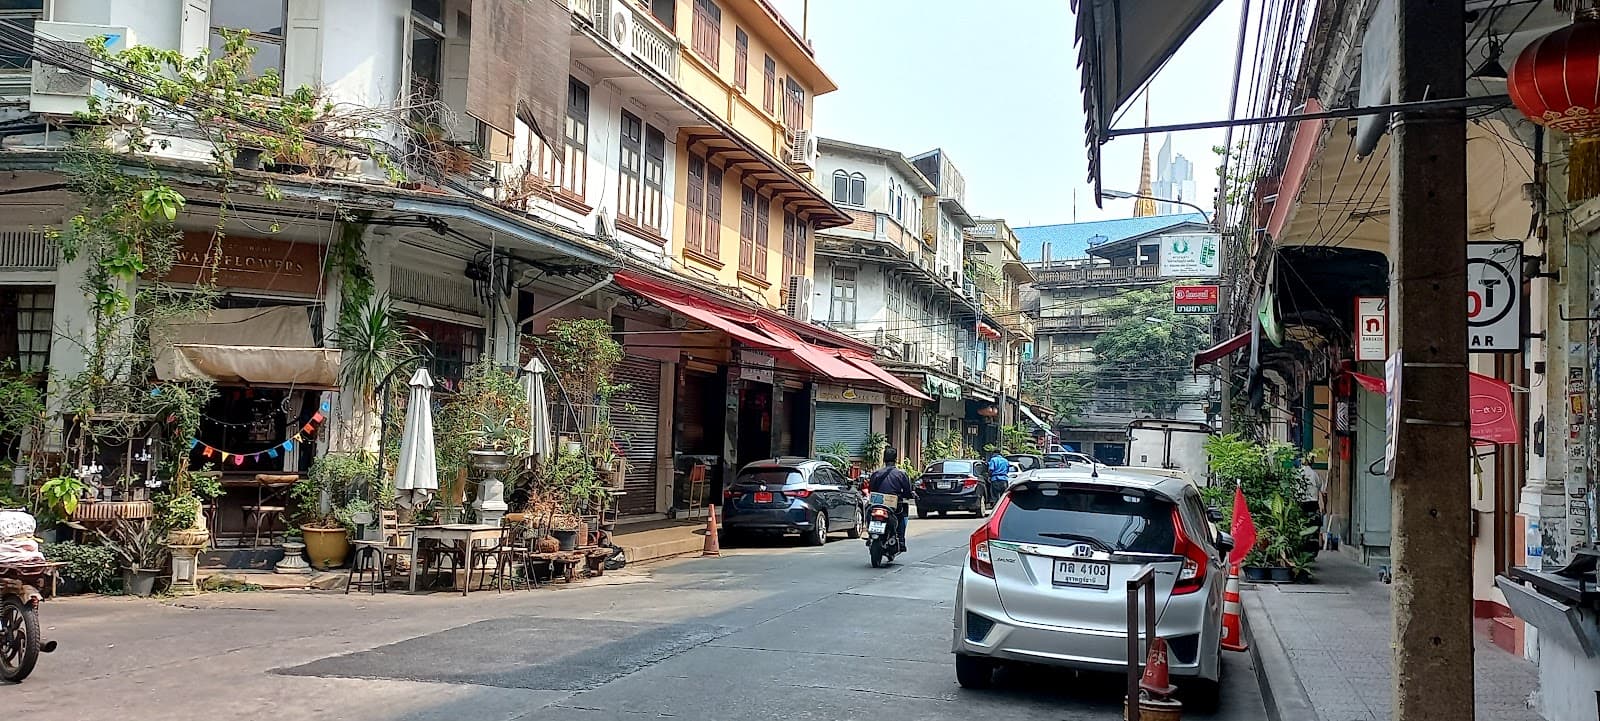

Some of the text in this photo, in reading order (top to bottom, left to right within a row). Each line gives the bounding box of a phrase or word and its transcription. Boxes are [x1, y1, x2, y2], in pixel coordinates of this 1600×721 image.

[176, 251, 304, 272] WALFLOWERS
[1471, 335, 1494, 346] AR
[1080, 564, 1106, 576] 4103
